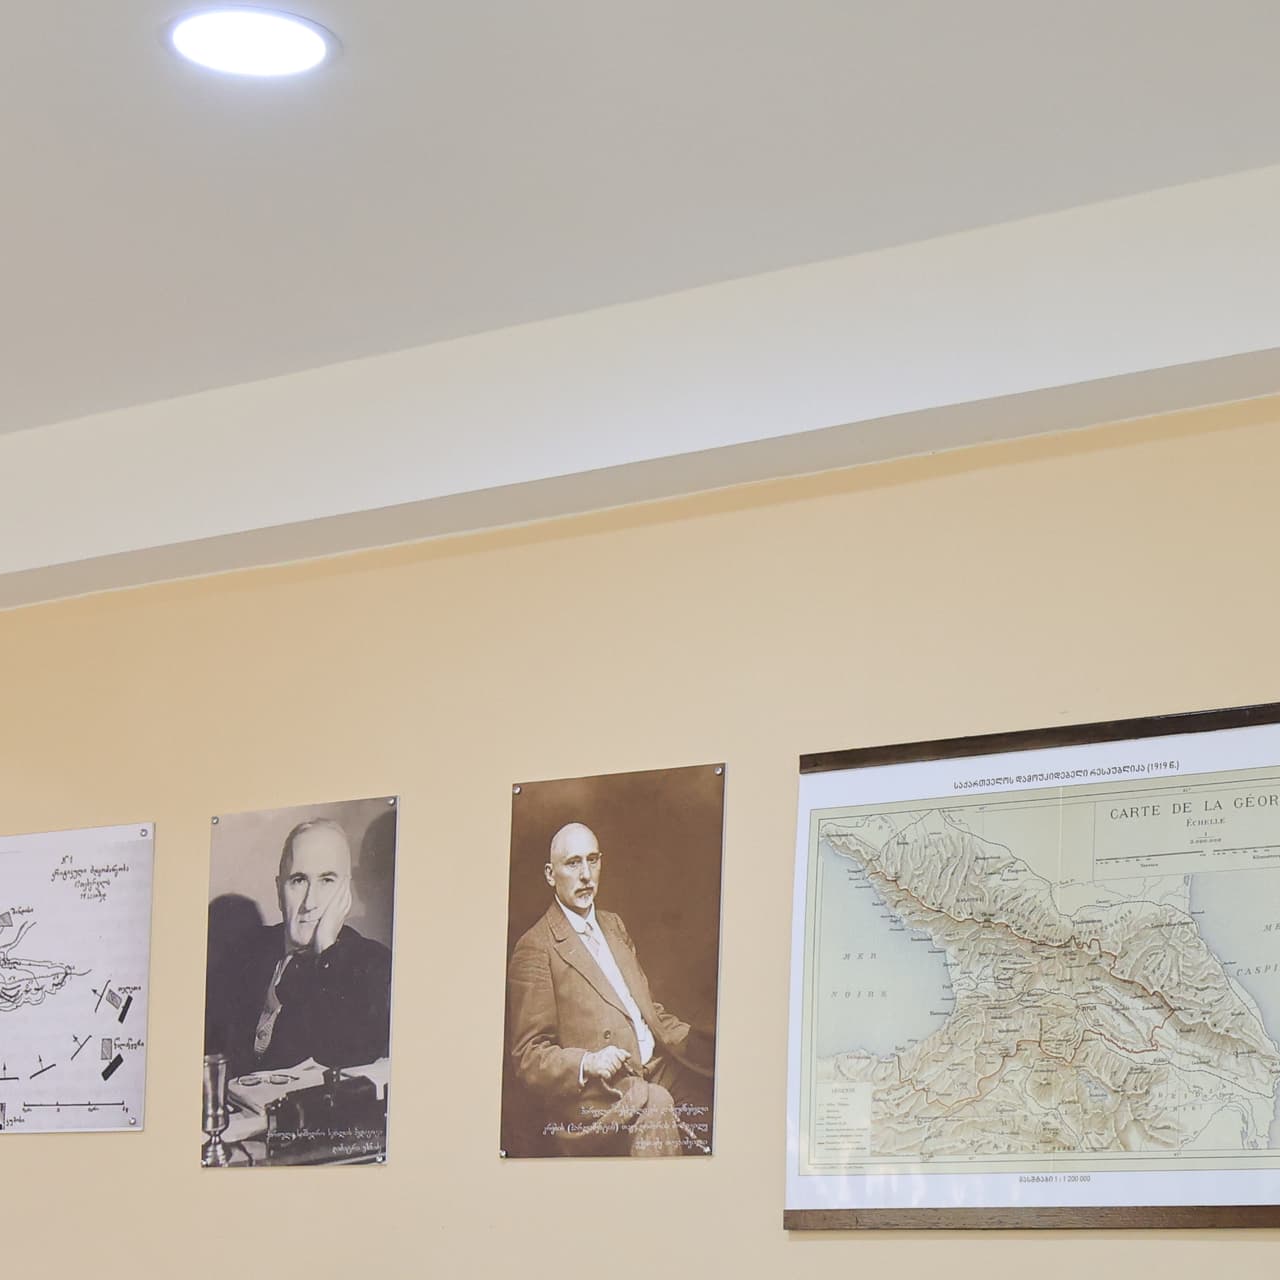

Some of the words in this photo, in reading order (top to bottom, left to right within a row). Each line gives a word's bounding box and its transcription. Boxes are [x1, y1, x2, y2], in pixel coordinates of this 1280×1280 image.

[1110, 805, 1161, 820] CARTE
[1172, 802, 1193, 815] DE
[1204, 799, 1224, 812] LA
